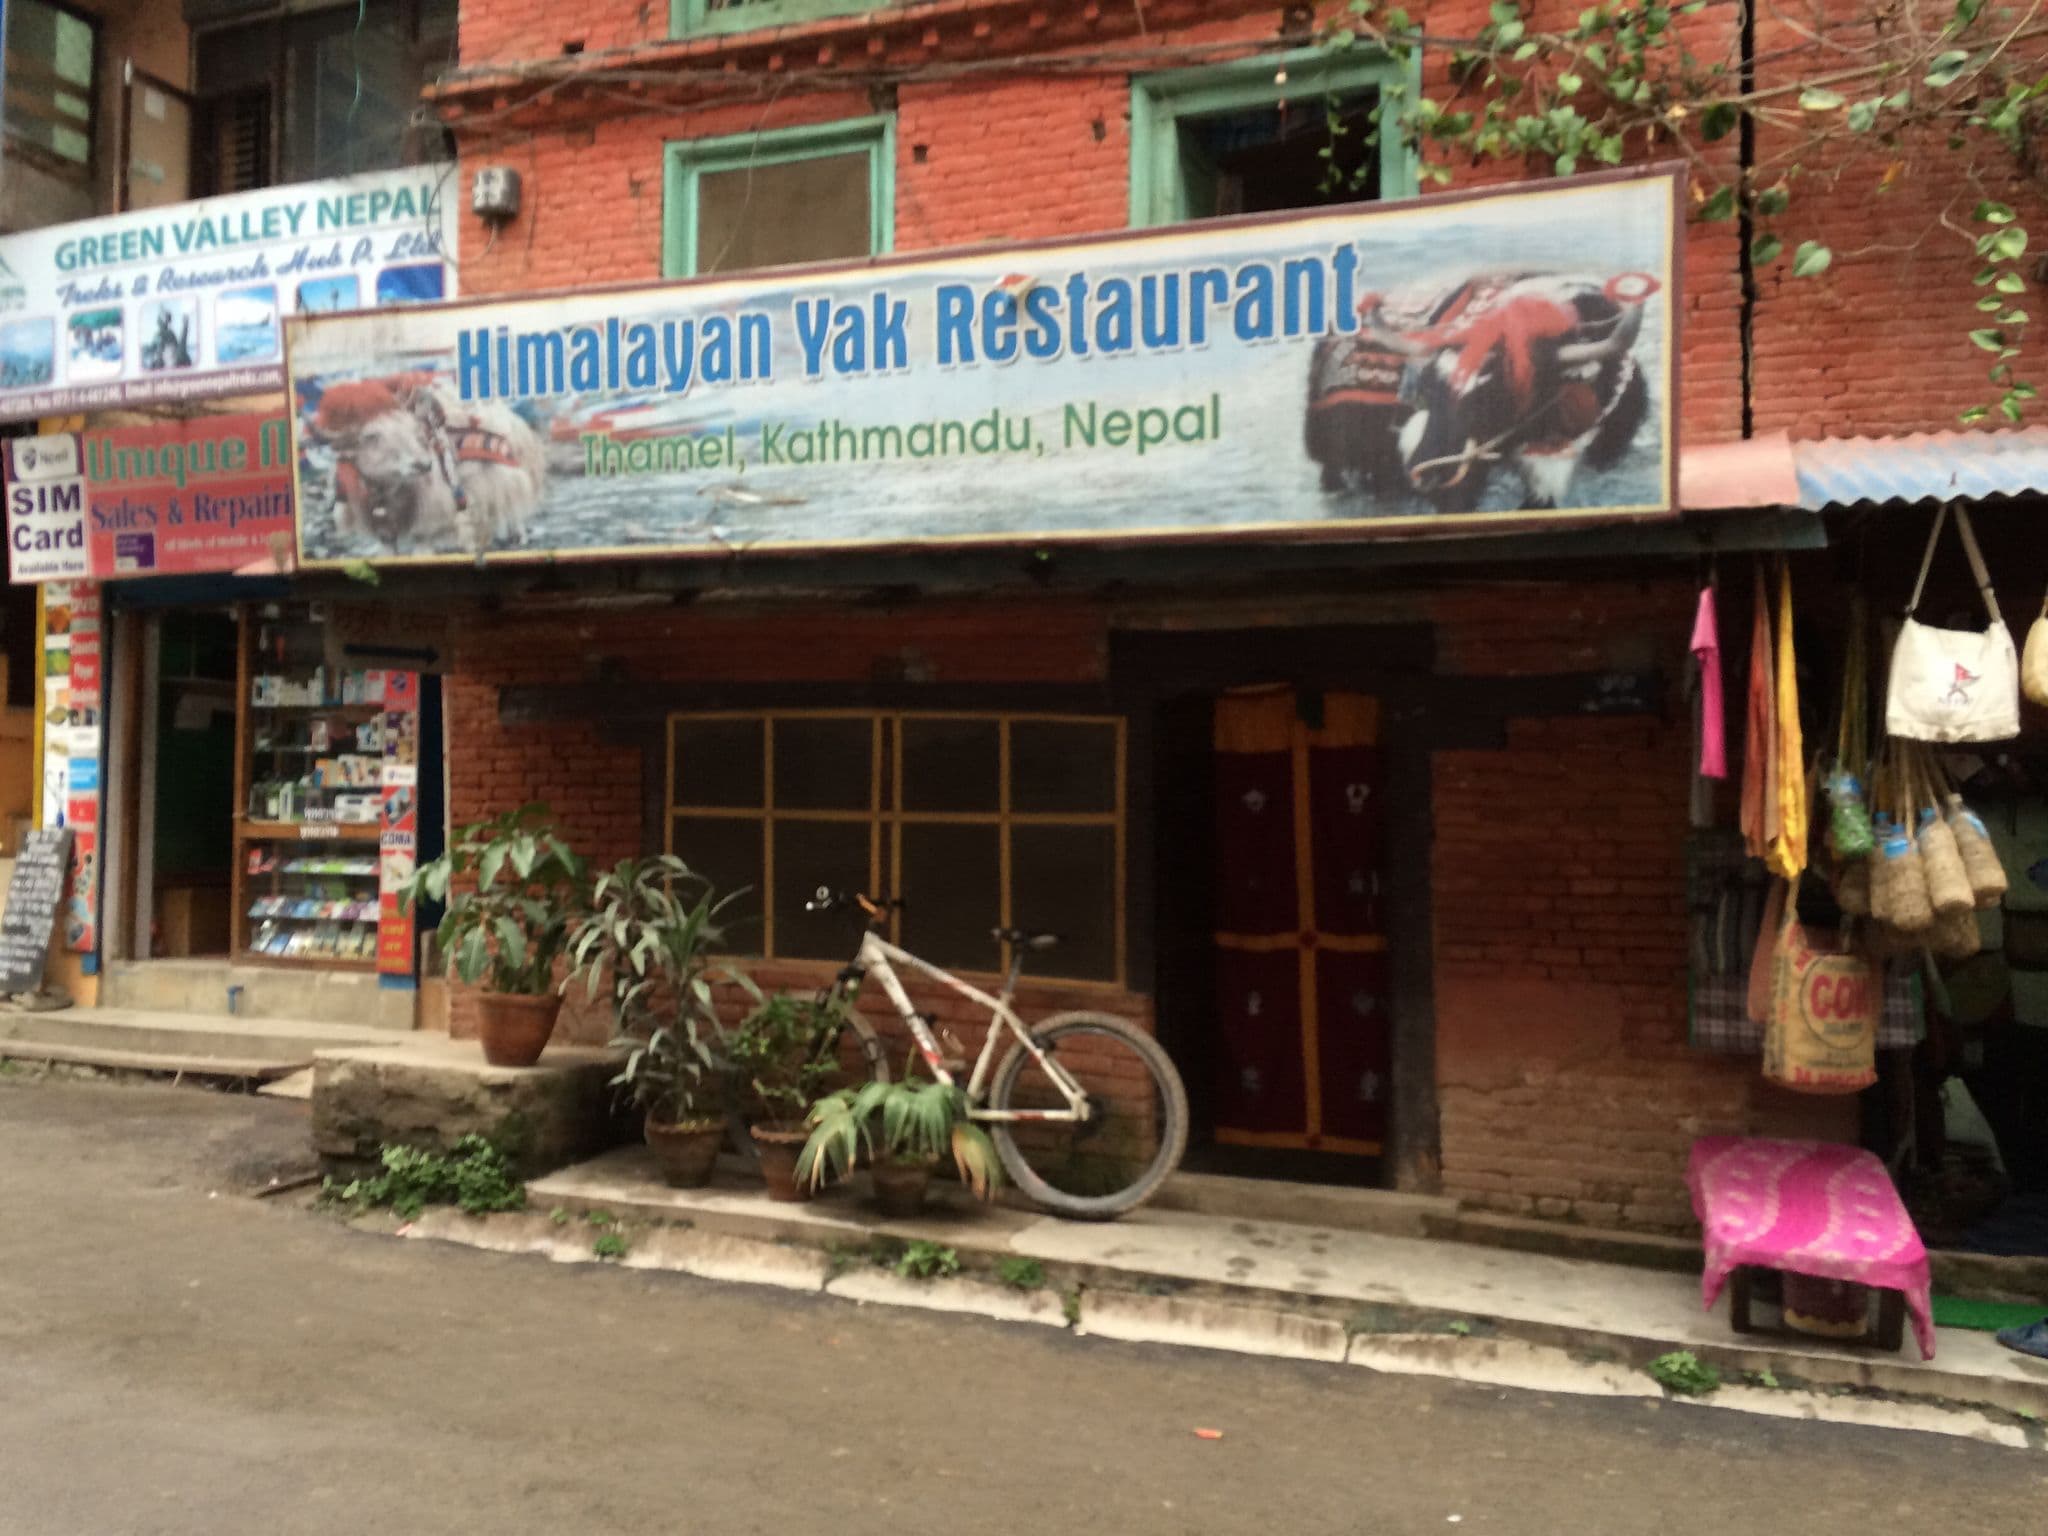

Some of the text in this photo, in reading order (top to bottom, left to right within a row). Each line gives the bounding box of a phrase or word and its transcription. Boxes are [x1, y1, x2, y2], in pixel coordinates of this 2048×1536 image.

[54, 184, 442, 271] GREEN VALLEY NEPAL
[156, 252, 269, 293] Research
[275, 240, 344, 276] Hub
[457, 242, 1360, 401] Himalayan Yak Restaurant
[581, 392, 1221, 474] Thamel, Kathmandu, Nepal
[87, 436, 247, 488] Unique
[13, 483, 81, 515] SIM
[91, 496, 158, 530] Sales
[167, 499, 184, 525] &
[13, 519, 84, 552] Card
